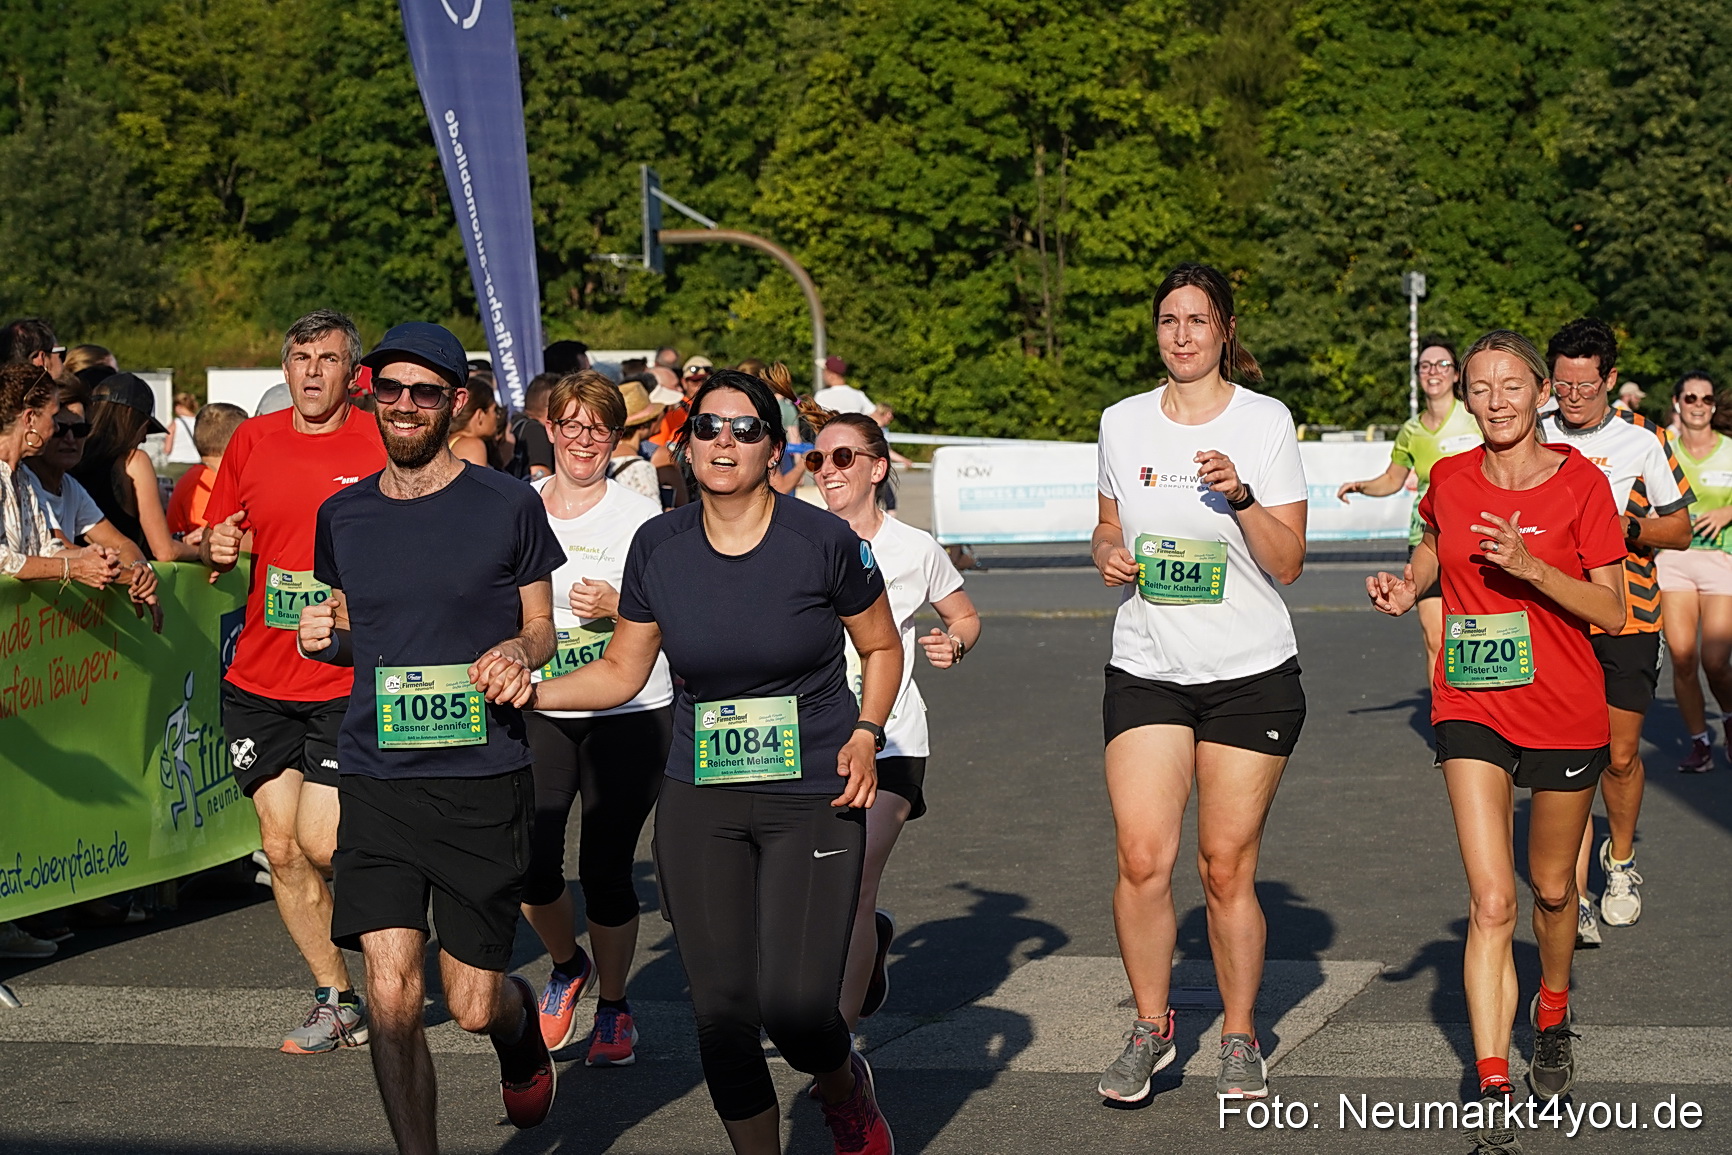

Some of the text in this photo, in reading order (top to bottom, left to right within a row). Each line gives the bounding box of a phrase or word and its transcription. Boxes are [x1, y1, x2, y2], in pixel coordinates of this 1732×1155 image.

[1156, 559, 1202, 583] 184
[1210, 566, 1221, 596] 2022
[1173, 584, 1211, 593] Katharina
[38, 598, 106, 646] Firmen
[278, 610, 300, 619] Braun
[1456, 638, 1516, 664] 1720
[1518, 640, 1529, 674] 2022
[48, 632, 119, 706] länger!
[1463, 665, 1508, 674] Pfister Ute
[402, 680, 435, 689] Firmenlauf
[383, 704, 393, 732] RUN
[394, 693, 468, 721] 1085
[470, 696, 481, 733] 2022
[716, 713, 748, 723] Firmenlauf
[392, 721, 471, 733] Gassner Jennifer
[699, 740, 708, 768] RUN
[709, 726, 782, 757] 1084
[783, 729, 795, 767] 2022
[707, 755, 785, 768] Reichert Melanie
